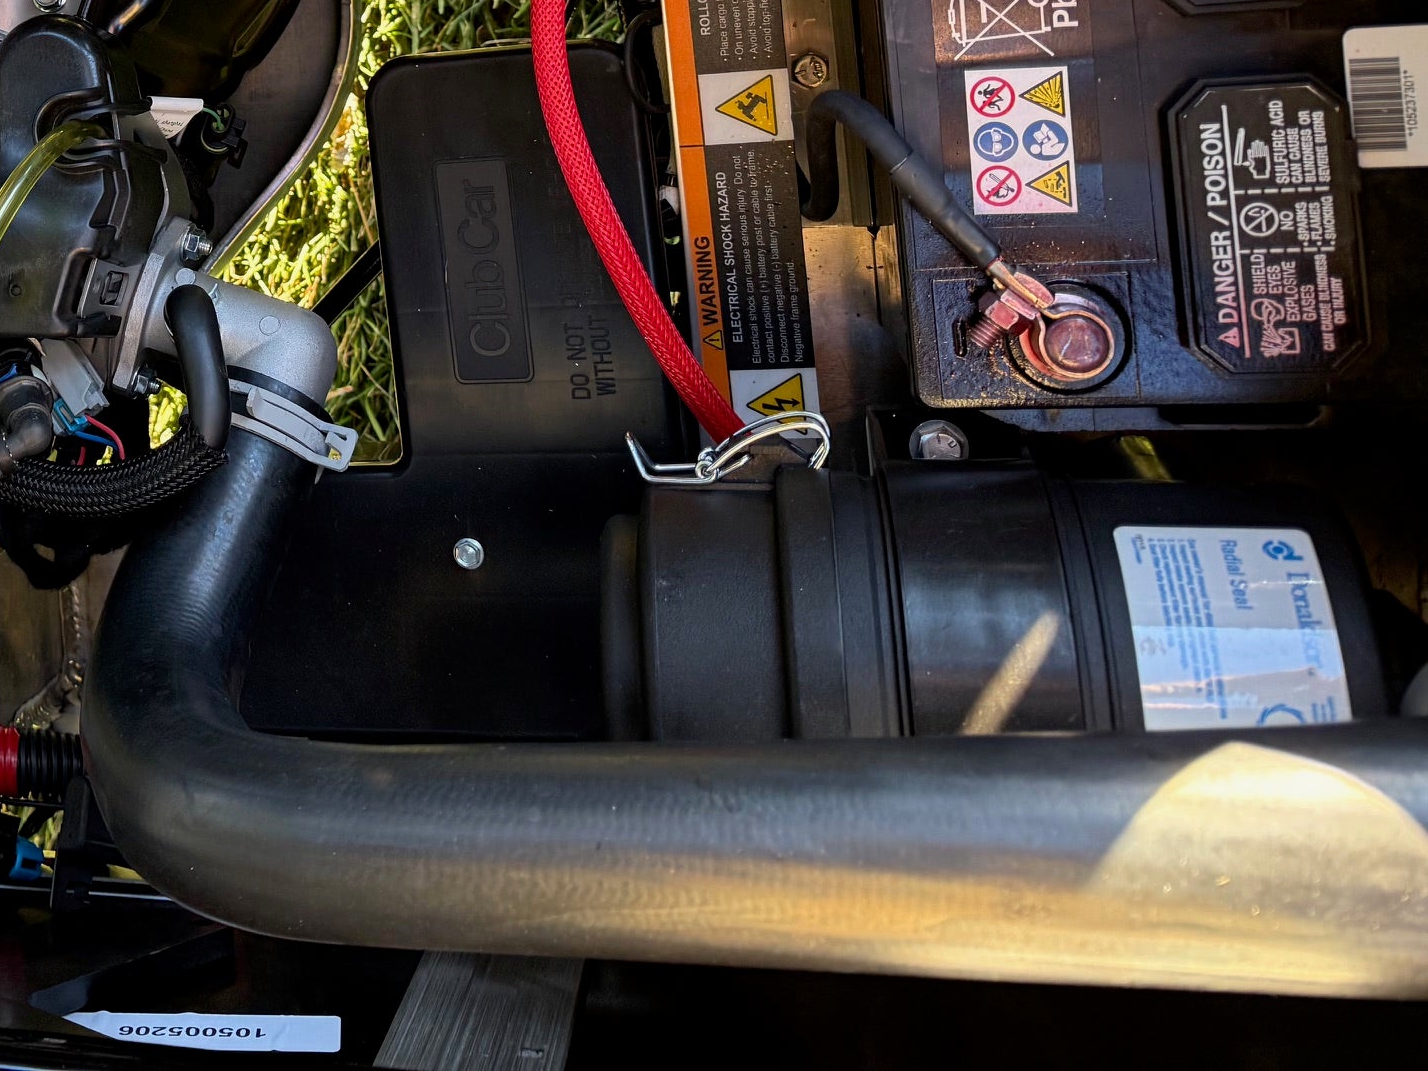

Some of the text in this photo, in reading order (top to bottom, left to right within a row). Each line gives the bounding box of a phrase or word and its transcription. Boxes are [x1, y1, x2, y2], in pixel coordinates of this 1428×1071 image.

[748, 29, 758, 53] Avoid
[1200, 123, 1226, 205] POISON
[1269, 100, 1289, 183] SULFURIC ACID
[1287, 128, 1302, 183] CAN CAUSE
[1299, 110, 1316, 182] BLINDNESS OR
[1312, 111, 1329, 181] SEVERE BURNS
[1280, 210, 1293, 230] NO
[1296, 202, 1309, 240] SPARKS
[1309, 202, 1322, 239] FLAMES
[1322, 196, 1335, 239] SMOKING
[694, 236, 718, 325] WARNING
[715, 171, 742, 342] ELECTRICAL SHOCK HAZARD
[732, 155, 761, 363] Electrical shock can cause serious injury. Do not
[1211, 231, 1238, 323] DANGER
[1251, 254, 1267, 294] SHIELD
[1267, 265, 1282, 293] EYES
[1282, 261, 1300, 321] EXPLOSIVE
[1301, 284, 1317, 320] GASES
[563, 323, 587, 361] NOT
[587, 316, 616, 396] WITHOUT
[570, 373, 591, 400] DO
[119, 1025, 267, 1039] 105005206
